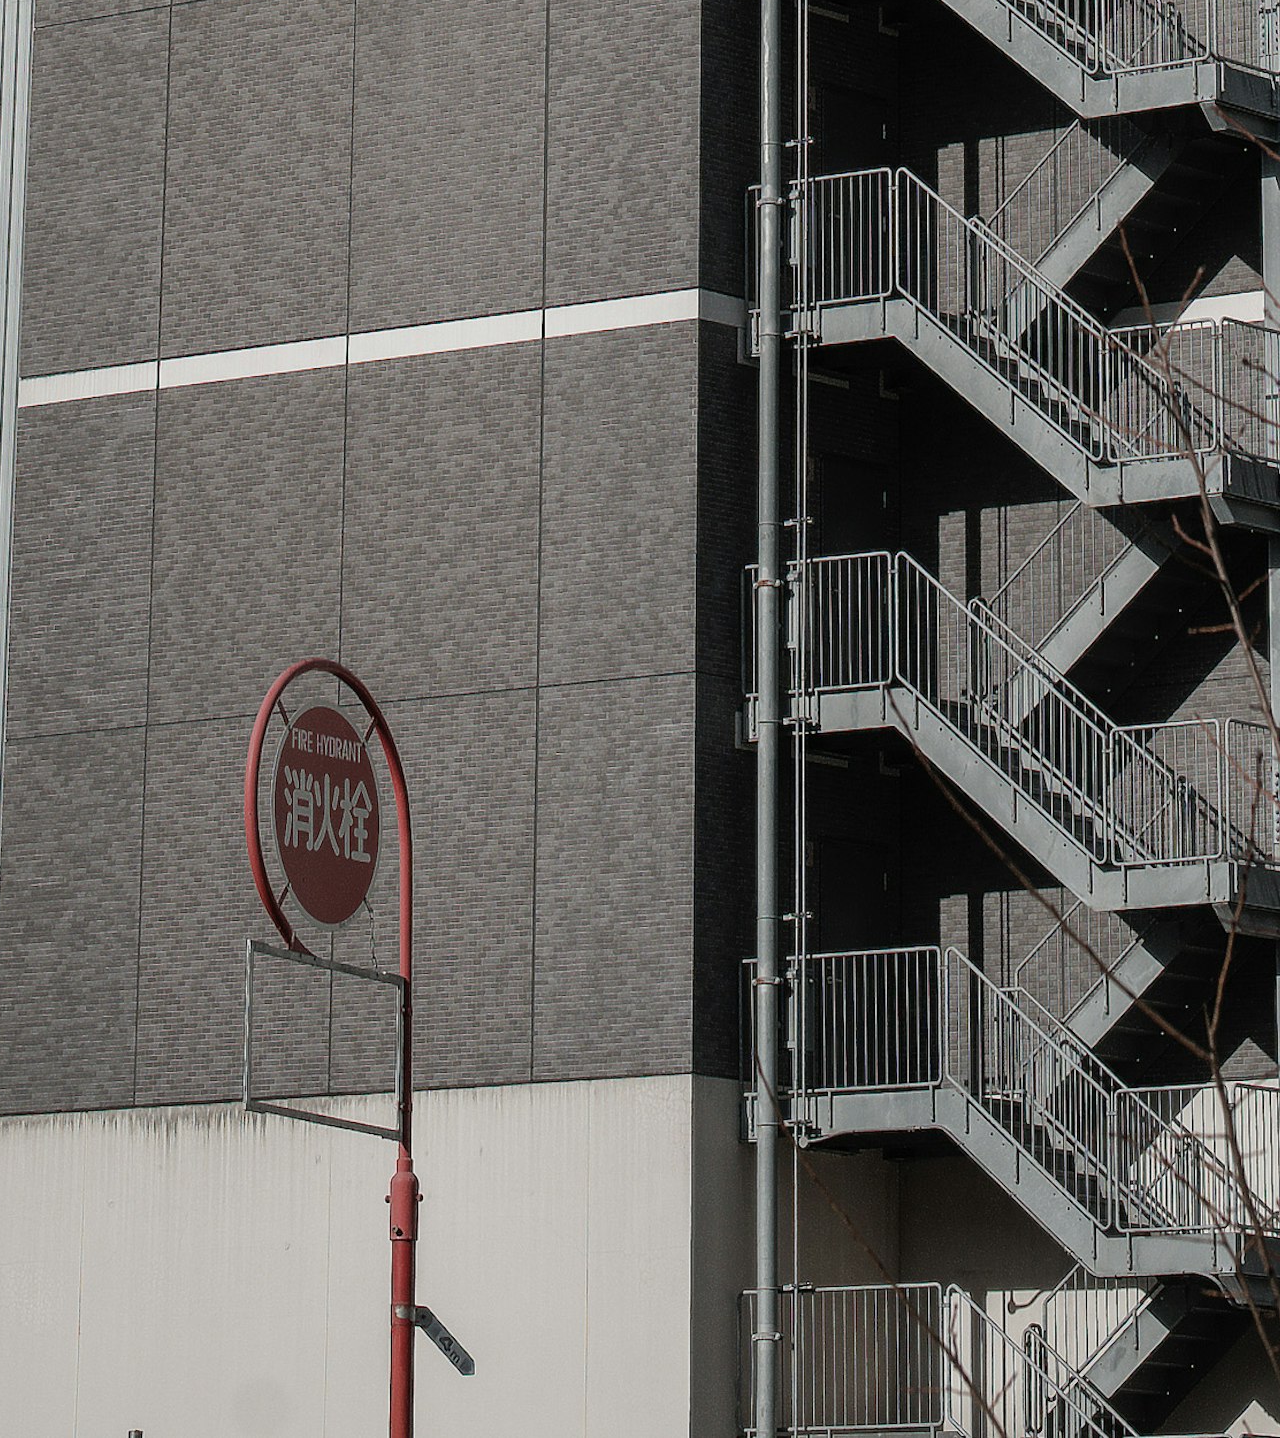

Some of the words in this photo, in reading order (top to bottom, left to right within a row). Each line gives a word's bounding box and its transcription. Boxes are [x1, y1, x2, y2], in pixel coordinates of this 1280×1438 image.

[291, 727, 313, 753] FIRE
[316, 733, 363, 763] HYDRANT
[284, 765, 372, 863] 消火栓
